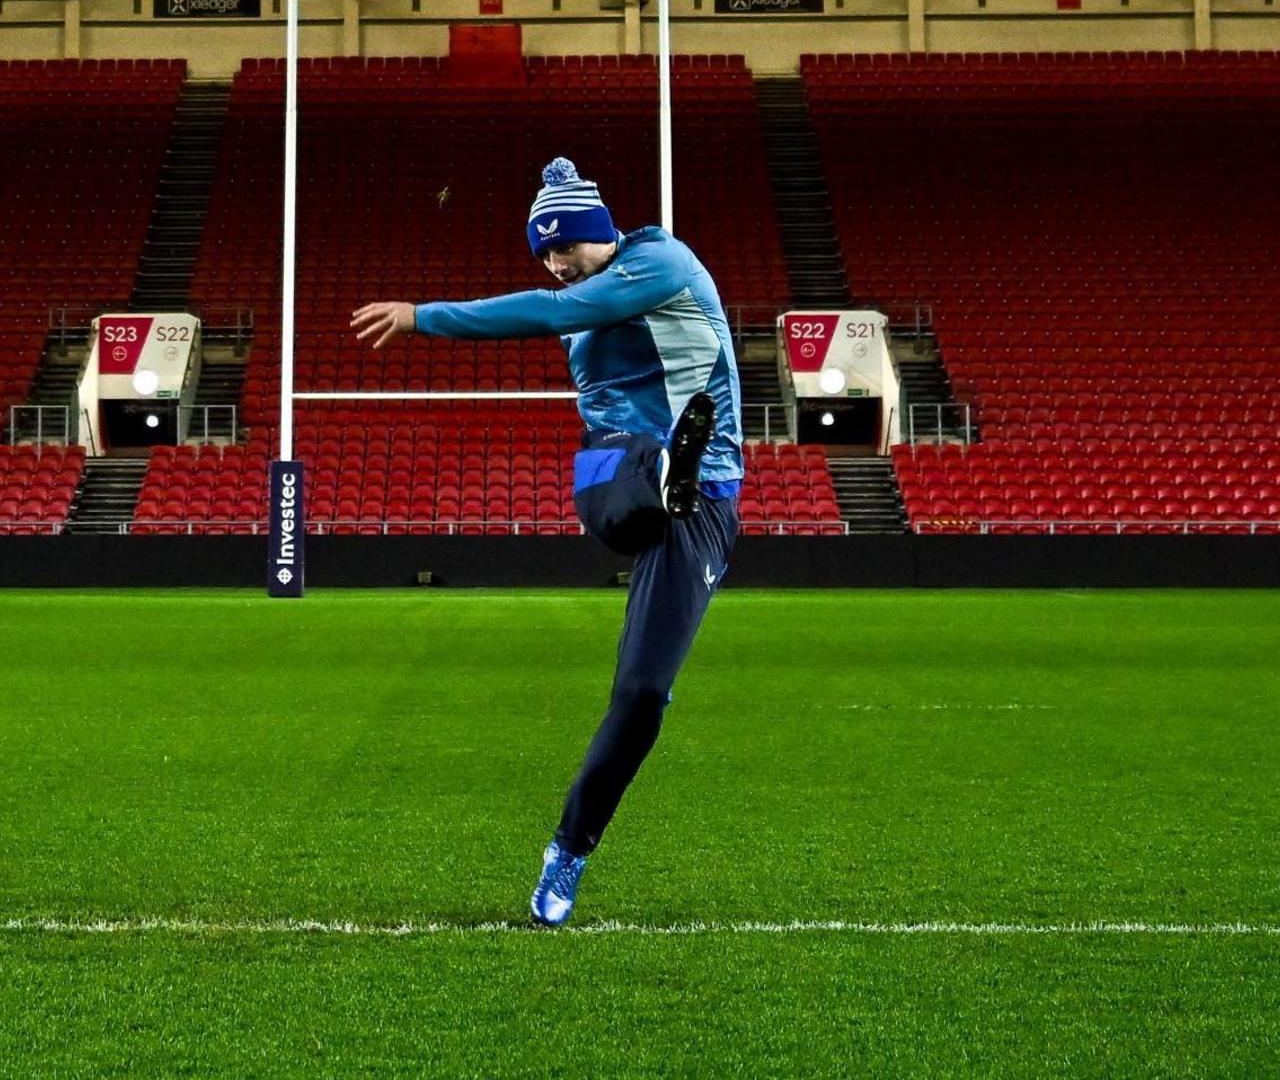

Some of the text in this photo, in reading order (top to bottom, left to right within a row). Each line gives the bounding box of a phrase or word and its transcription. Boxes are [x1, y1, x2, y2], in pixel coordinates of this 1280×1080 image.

[104, 326, 138, 342] S23
[156, 326, 189, 342] S22
[790, 322, 825, 339] S22
[846, 322, 875, 338] S21
[276, 473, 296, 565] Investec
